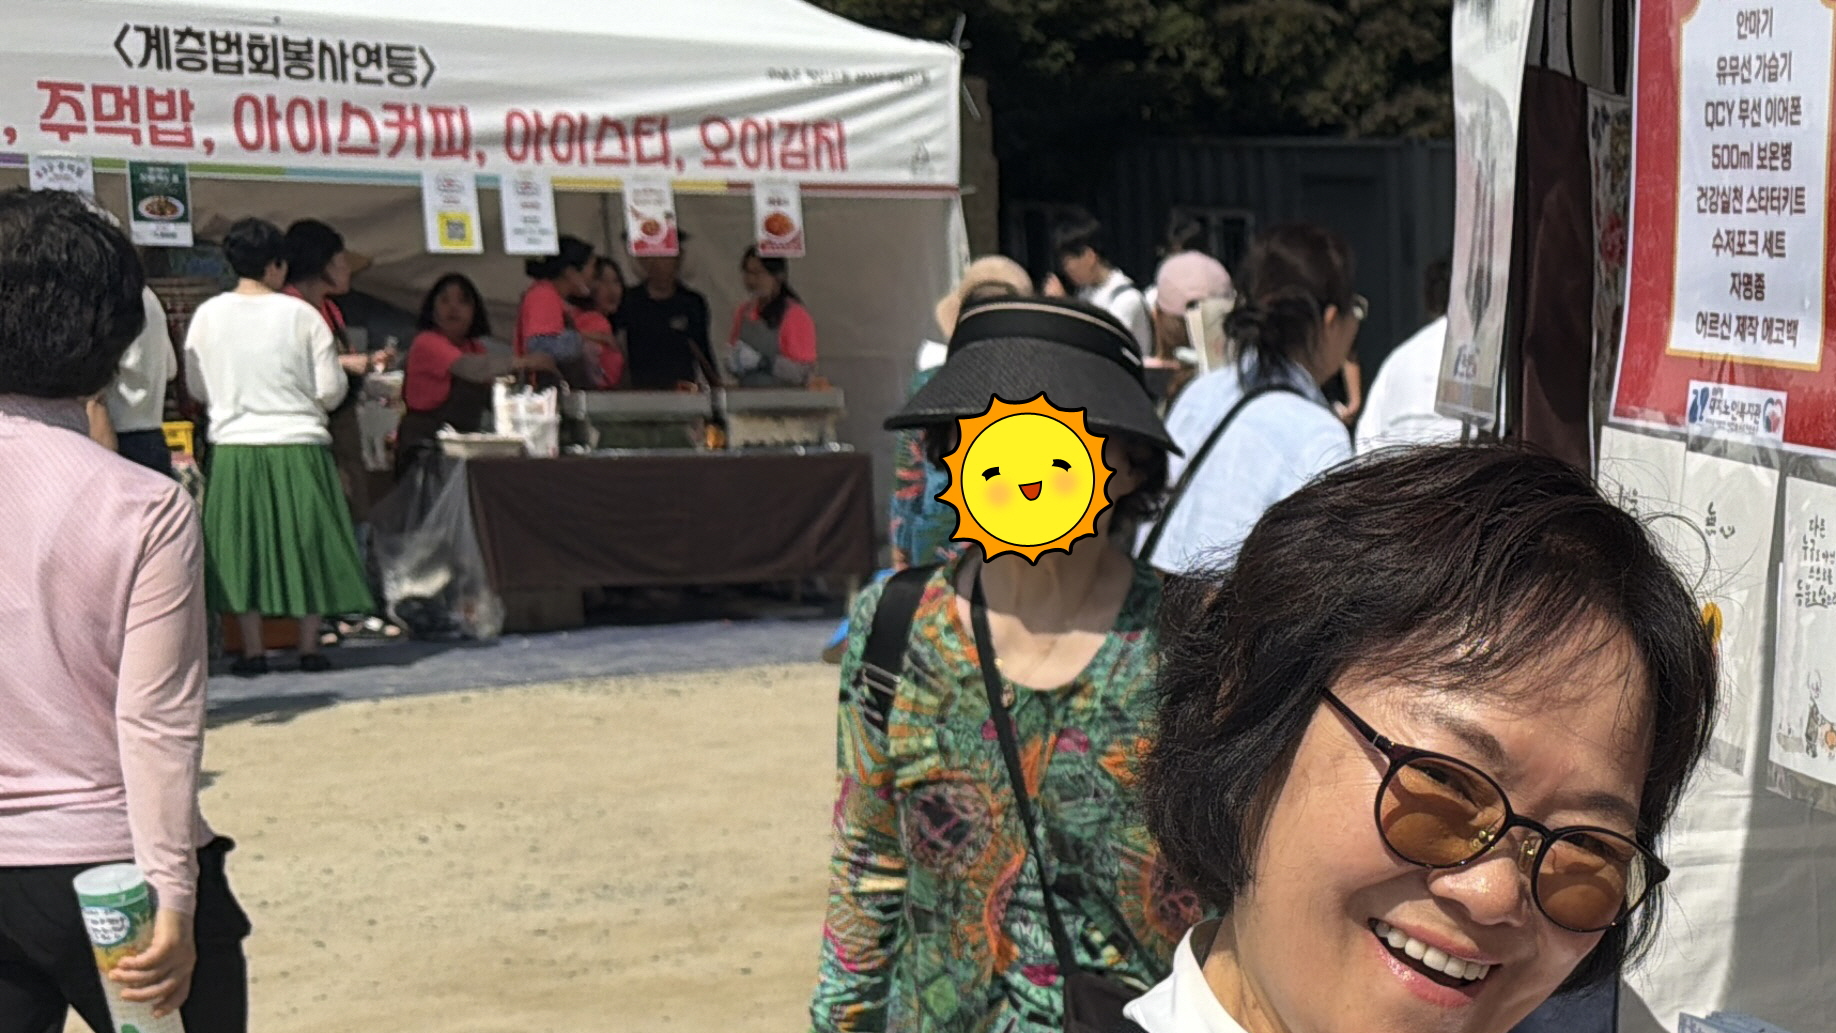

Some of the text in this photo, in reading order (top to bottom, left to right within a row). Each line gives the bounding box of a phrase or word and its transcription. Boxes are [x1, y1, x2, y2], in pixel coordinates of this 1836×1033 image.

[1736, 6, 1773, 40] 안마기
[1716, 50, 1792, 86] 유무선 가습기
[37, 80, 848, 172] 주먹밥, 아이스커피, 아이스티, 오이김치
[1704, 95, 1801, 131] QCY 무선 이어폰
[1711, 141, 1792, 171] 500ml 보온병
[1696, 184, 1806, 215] 건강실천 스타터키트
[1711, 227, 1786, 258] 수저포크 세트
[1729, 271, 1765, 301] 자명종
[1695, 310, 1799, 347] 어르신 제작 에코백
